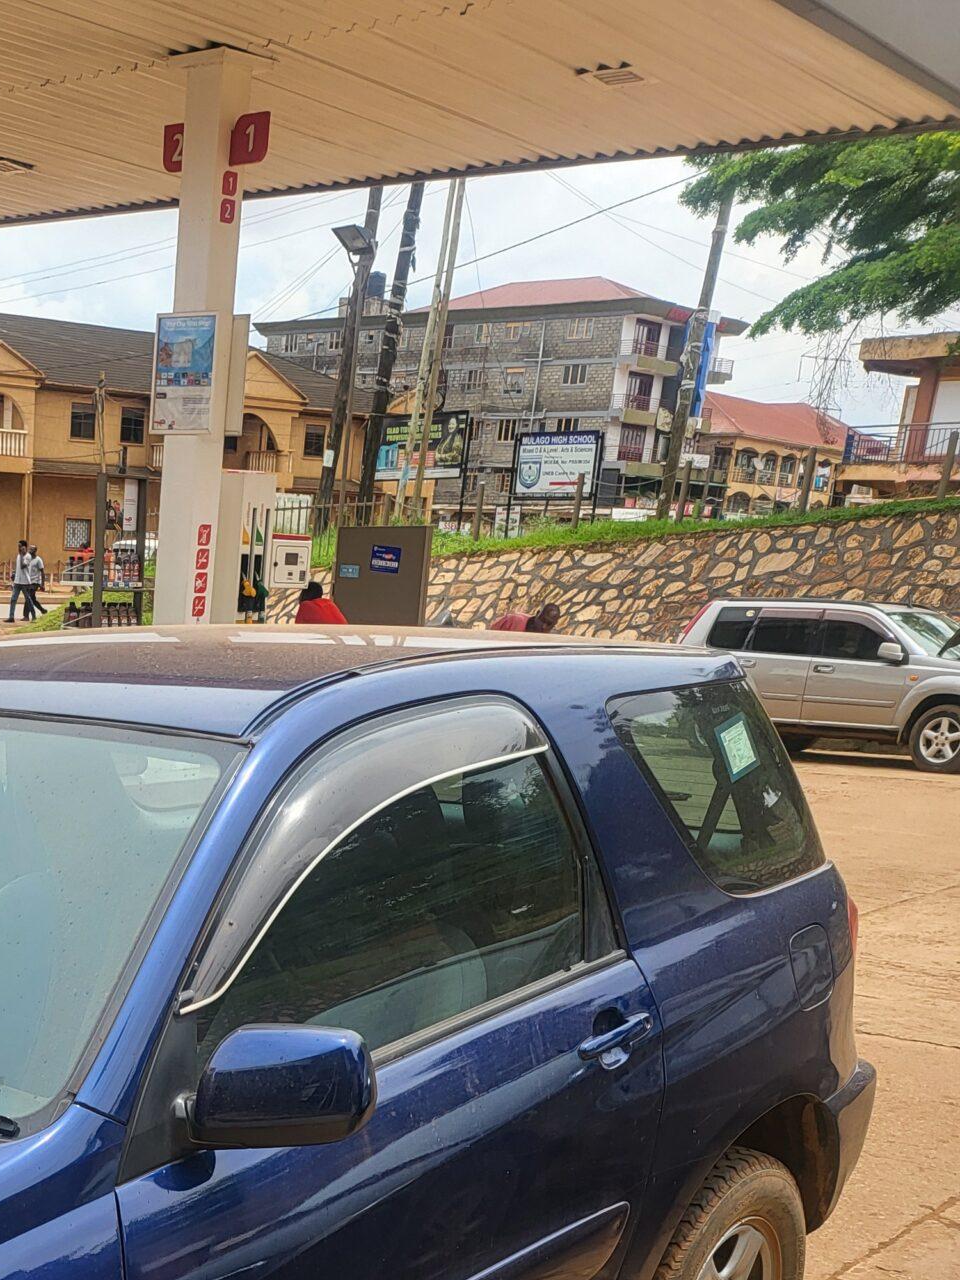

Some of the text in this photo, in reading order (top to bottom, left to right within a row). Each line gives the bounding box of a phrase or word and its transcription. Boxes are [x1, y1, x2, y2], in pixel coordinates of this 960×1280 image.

[245, 124, 255, 152] 1
[171, 133, 183, 162] 2
[228, 177, 233, 190] 1
[224, 204, 231, 218] 2
[522, 434, 597, 445] MULAGO HIGH SCHOOL
